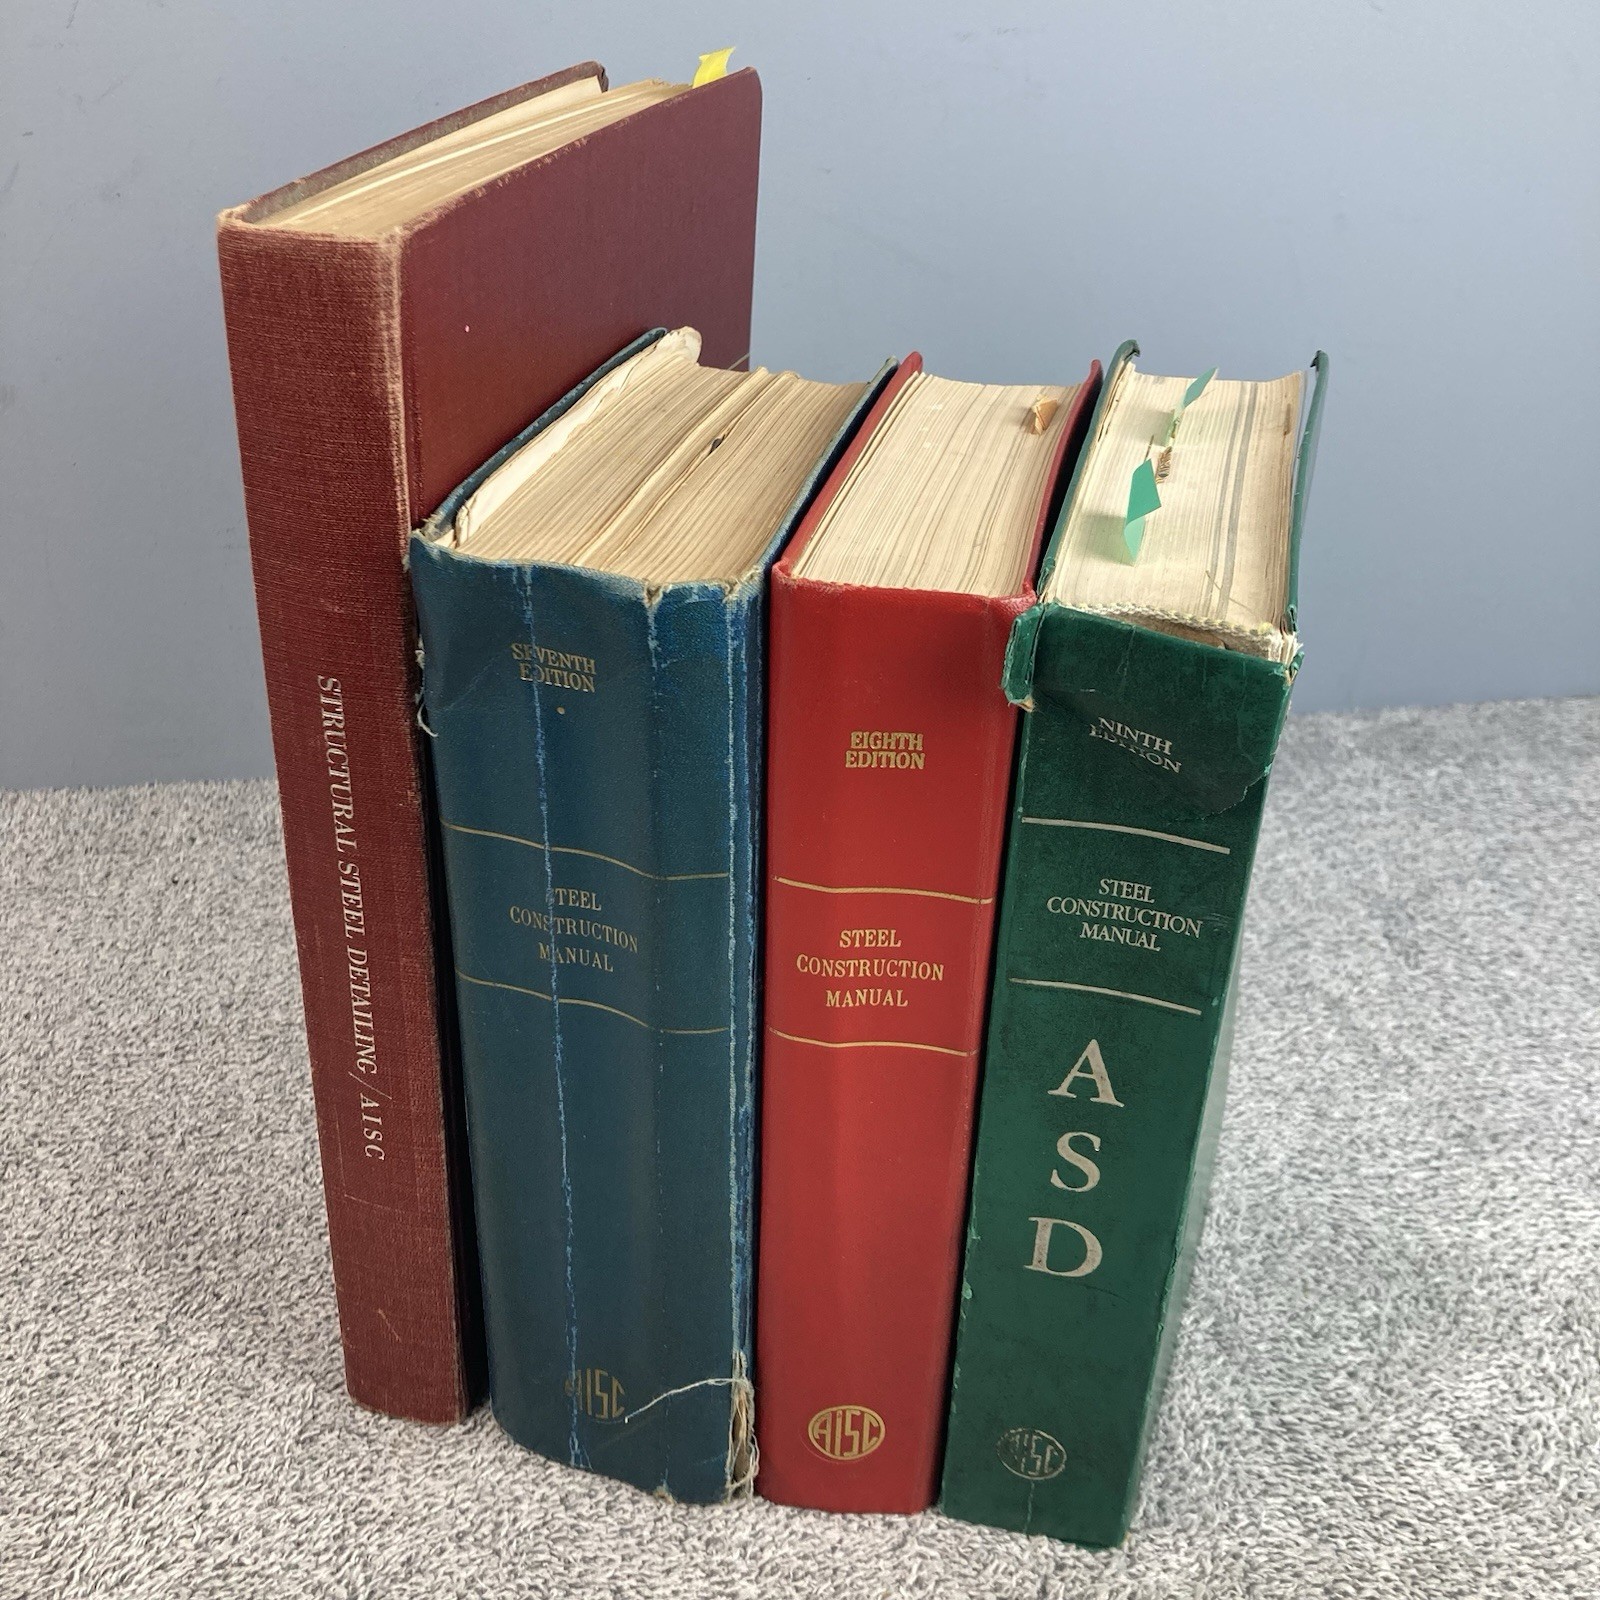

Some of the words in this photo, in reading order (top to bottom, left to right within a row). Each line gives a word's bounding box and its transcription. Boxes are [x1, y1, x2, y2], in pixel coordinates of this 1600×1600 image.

[519, 662, 596, 693] EDITION
[850, 731, 924, 751] EIGHTH
[1098, 716, 1173, 755] NINTH
[845, 750, 926, 770] EDITION
[317, 674, 357, 853] STRUCTURAL
[337, 860, 366, 939] STEEL
[545, 887, 602, 911] TEEL
[1098, 878, 1155, 904] STEEL
[509, 905, 639, 953] CONSTRUCTION
[1046, 896, 1204, 938] CONSTRUCTION
[839, 929, 902, 949] STEEL
[1079, 921, 1161, 951] MANUAL
[538, 942, 614, 973] MANUAL
[796, 953, 945, 981] CONSTRUCTION
[825, 988, 909, 1008] MANUAL
[813, 1409, 880, 1457] AISC
